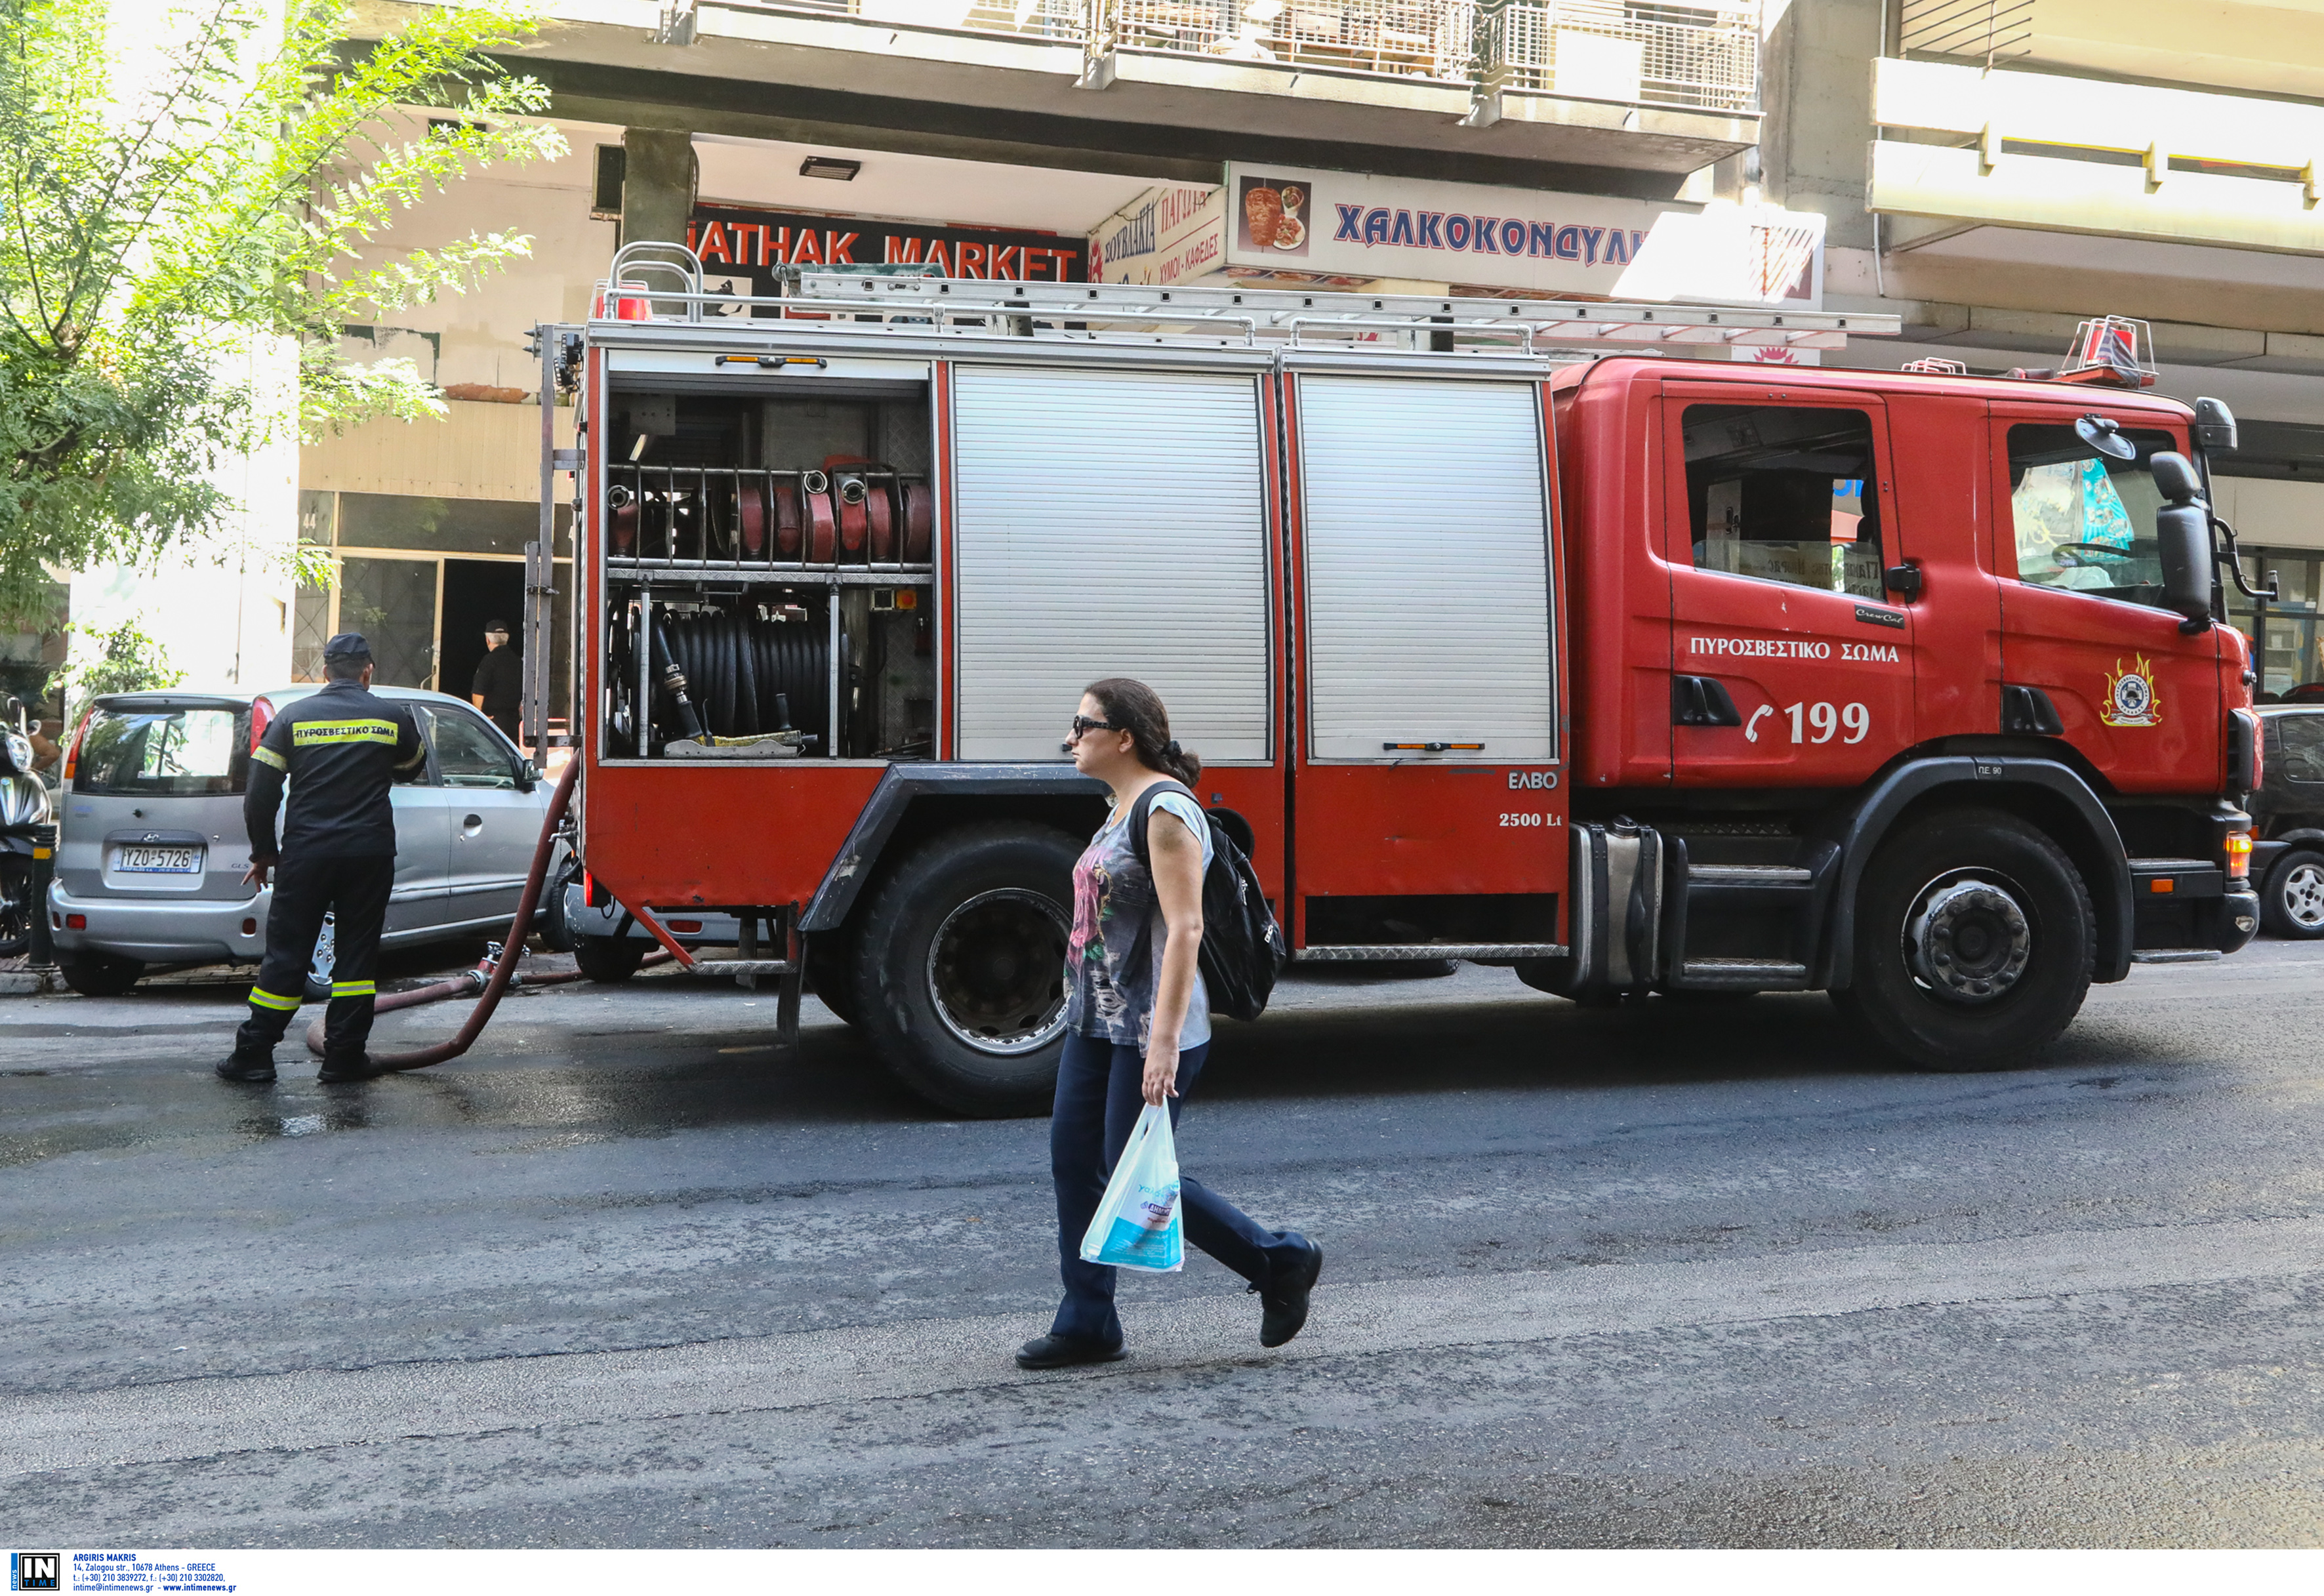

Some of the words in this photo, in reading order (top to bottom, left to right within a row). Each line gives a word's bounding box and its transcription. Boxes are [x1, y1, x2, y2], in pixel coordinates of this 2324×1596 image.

[1105, 197, 1156, 264] ΣΟΥΒΛΑΚΙΑ
[885, 235, 1077, 282] MARKET
[1160, 255, 1180, 285] ΧΥΜΟΙ
[1185, 233, 1219, 272] ΚΑΦΕΔΕΣ
[303, 513, 316, 529] 44
[1690, 637, 1831, 659] ΠΥΡΟΣΒΕΣΤΙΚΟ
[1841, 644, 1900, 663] ΣΩΜΑ
[296, 726, 369, 739] ΠΥΡΟΣΒΕΣΤΙΚΟ
[371, 726, 396, 738] ΣΩΜΑ
[1784, 701, 1870, 745] 199
[1509, 771, 1558, 790] ΕΛΒΟ
[1499, 813, 1541, 827] 2500
